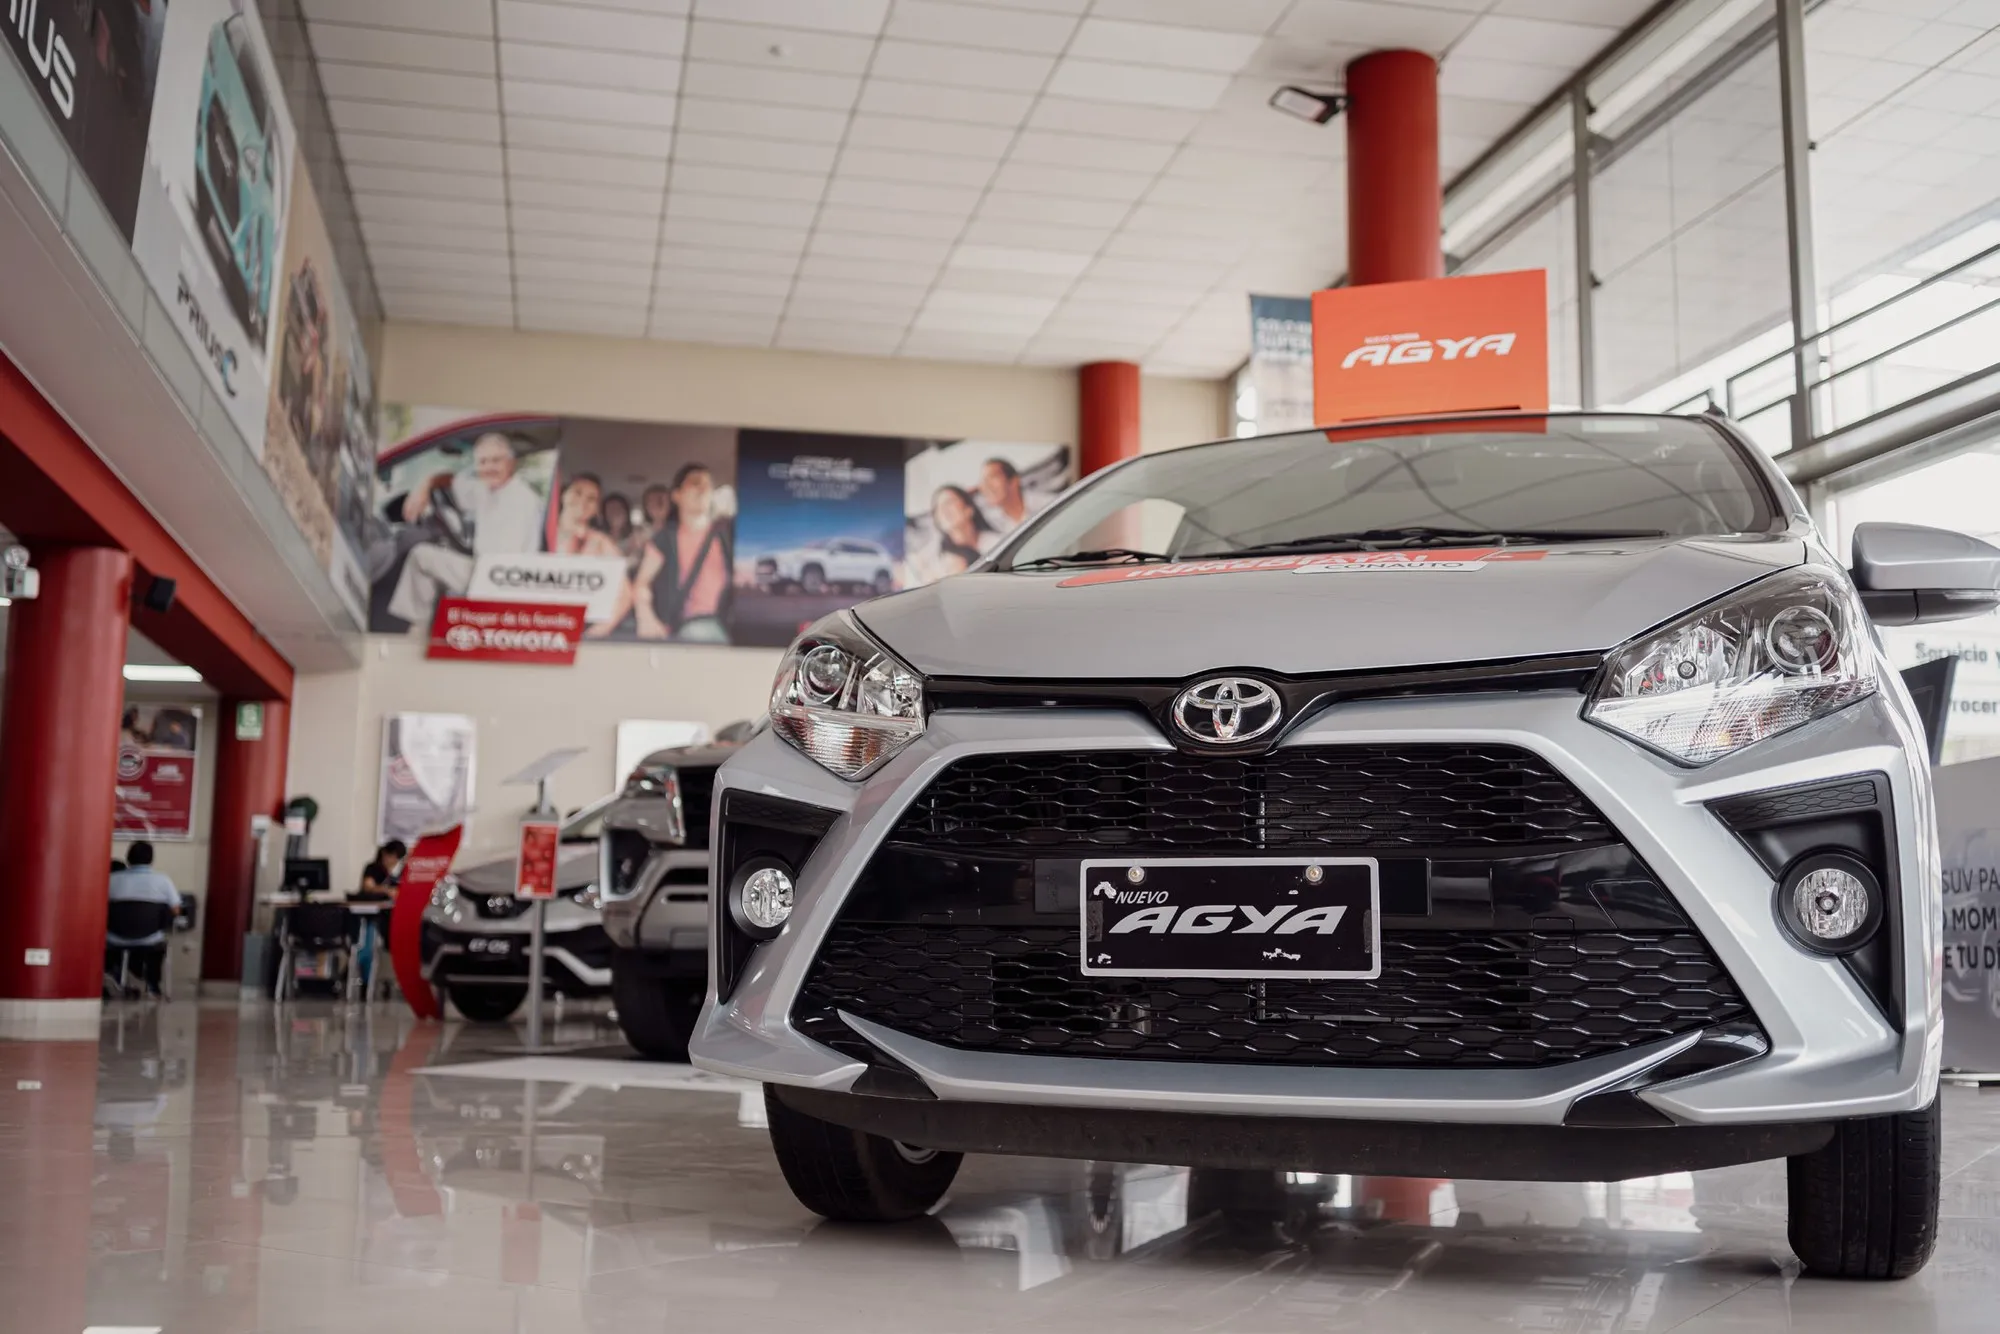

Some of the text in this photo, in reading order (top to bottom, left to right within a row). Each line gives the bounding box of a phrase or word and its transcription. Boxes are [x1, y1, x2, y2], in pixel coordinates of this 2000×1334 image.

[1341, 333, 1516, 369] AGYA
[1324, 561, 1464, 570] CONAUTO
[489, 566, 606, 591] CONAUTO
[481, 628, 569, 652] TOYOTA
[1115, 891, 1169, 904] NUEVO
[1108, 904, 1348, 935] AGYA
